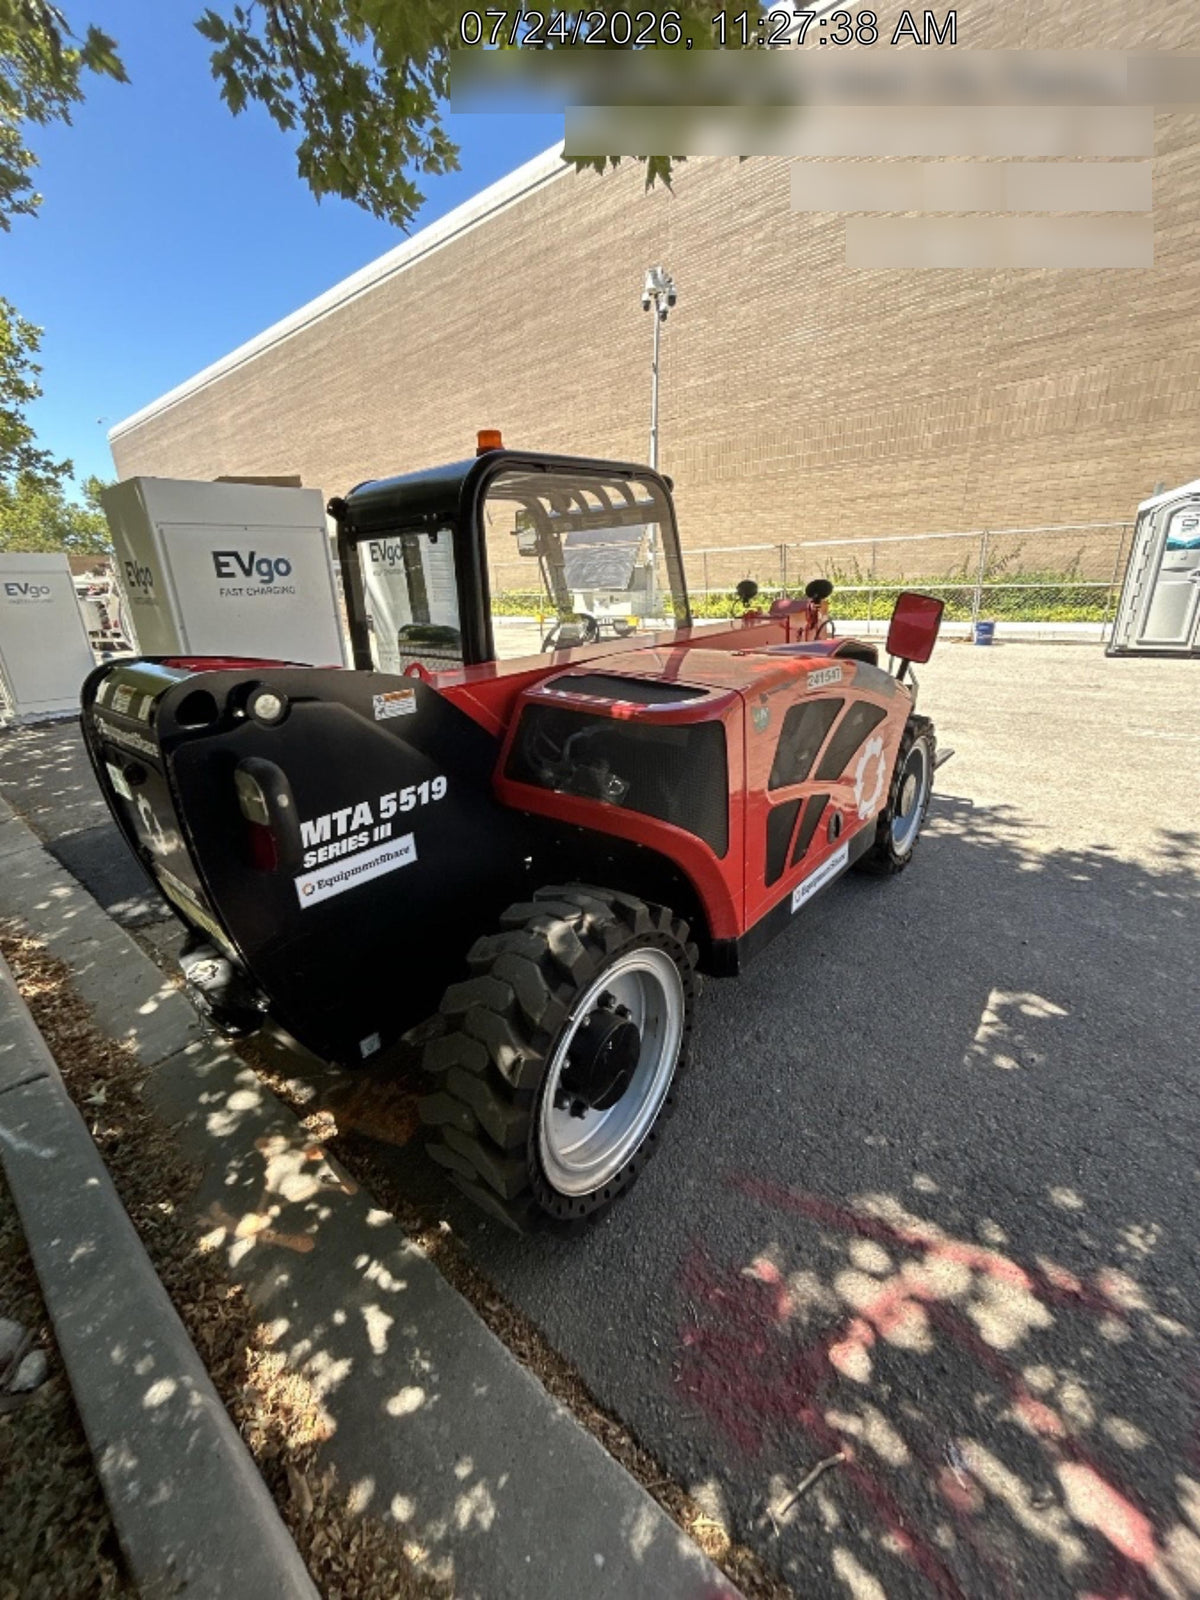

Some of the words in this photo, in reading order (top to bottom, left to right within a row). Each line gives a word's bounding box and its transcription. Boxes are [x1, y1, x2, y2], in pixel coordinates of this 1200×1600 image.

[124, 560, 154, 594] EVgo
[212, 551, 292, 584] EVgo
[4, 582, 50, 598] EVgo
[219, 587, 243, 597] FAST
[246, 585, 296, 597] CHARGING
[300, 801, 374, 849] MTA
[379, 775, 448, 819] 5519
[303, 831, 370, 869] SERIES
[373, 822, 393, 842] III
[316, 845, 411, 890] EquipmentShare
